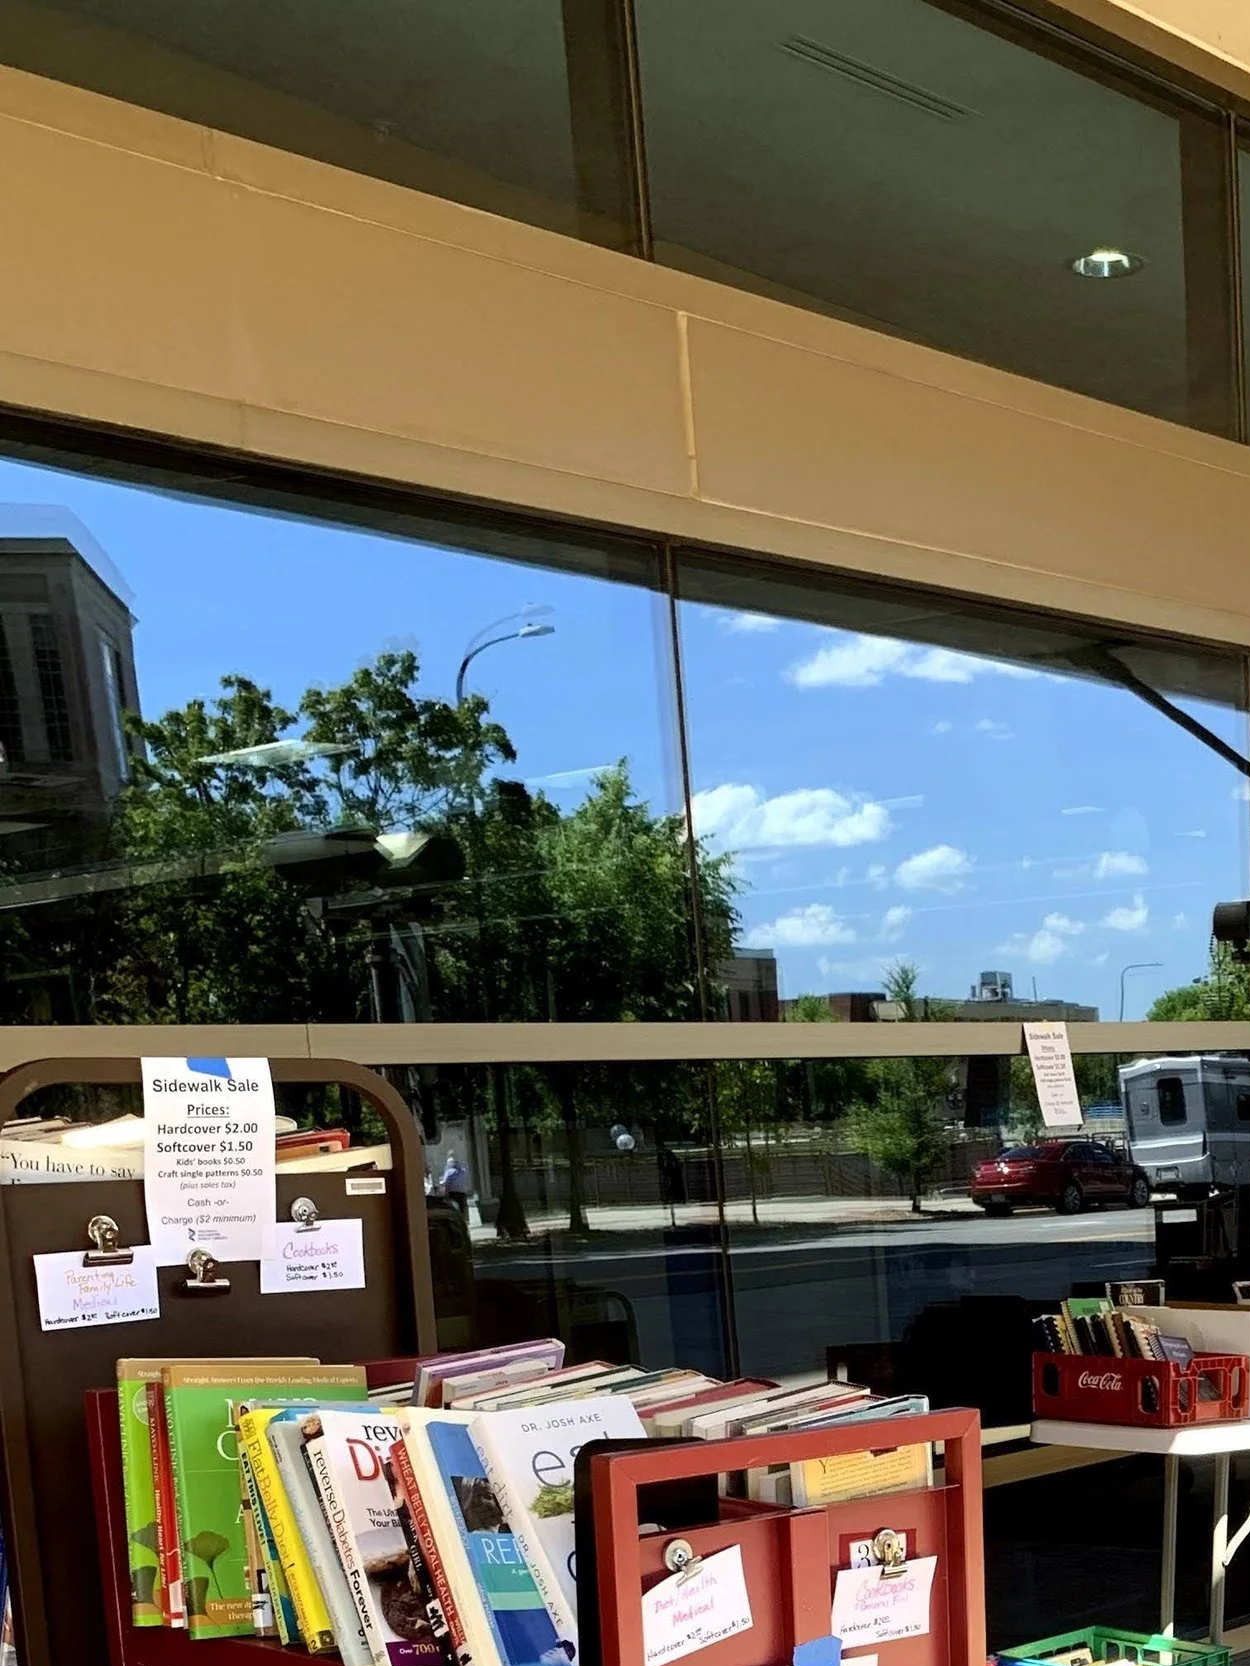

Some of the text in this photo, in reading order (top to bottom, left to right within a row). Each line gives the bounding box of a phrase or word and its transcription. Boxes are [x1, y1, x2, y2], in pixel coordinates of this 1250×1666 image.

[153, 1079, 259, 1092] Sidewalk Sale
[187, 1104, 230, 1116] Prices:
[157, 1122, 258, 1135] Hardcover $2.00
[157, 1140, 253, 1153] Softcover $1.50
[46, 1155, 84, 1175] have
[90, 1164, 105, 1176] to
[110, 1166, 136, 1179] say
[176, 1157, 246, 1166] Kids' books $0.50
[158, 1169, 263, 1179] Craft single patterns $0.50
[187, 1198, 211, 1207] Cash
[162, 1216, 193, 1225] Charge
[283, 1242, 339, 1259] Cookbooks
[521, 1413, 602, 1433] DR. JOSH AXE
[165, 1396, 179, 1474] MAYO CLINIC
[242, 1452, 259, 1506] EAT THIS
[248, 1439, 265, 1478] Flat
[259, 1476, 278, 1522] Belly
[398, 1447, 456, 1615] WHEAT BELLY TOTAL HEALTH
[476, 1446, 494, 1475] eat
[493, 1481, 512, 1518] dirt
[530, 1563, 549, 1596] JOSH
[548, 1602, 563, 1627] AXE
[313, 1450, 373, 1631] reverse Diabetes Forever
[413, 1643, 435, 1656] 700
